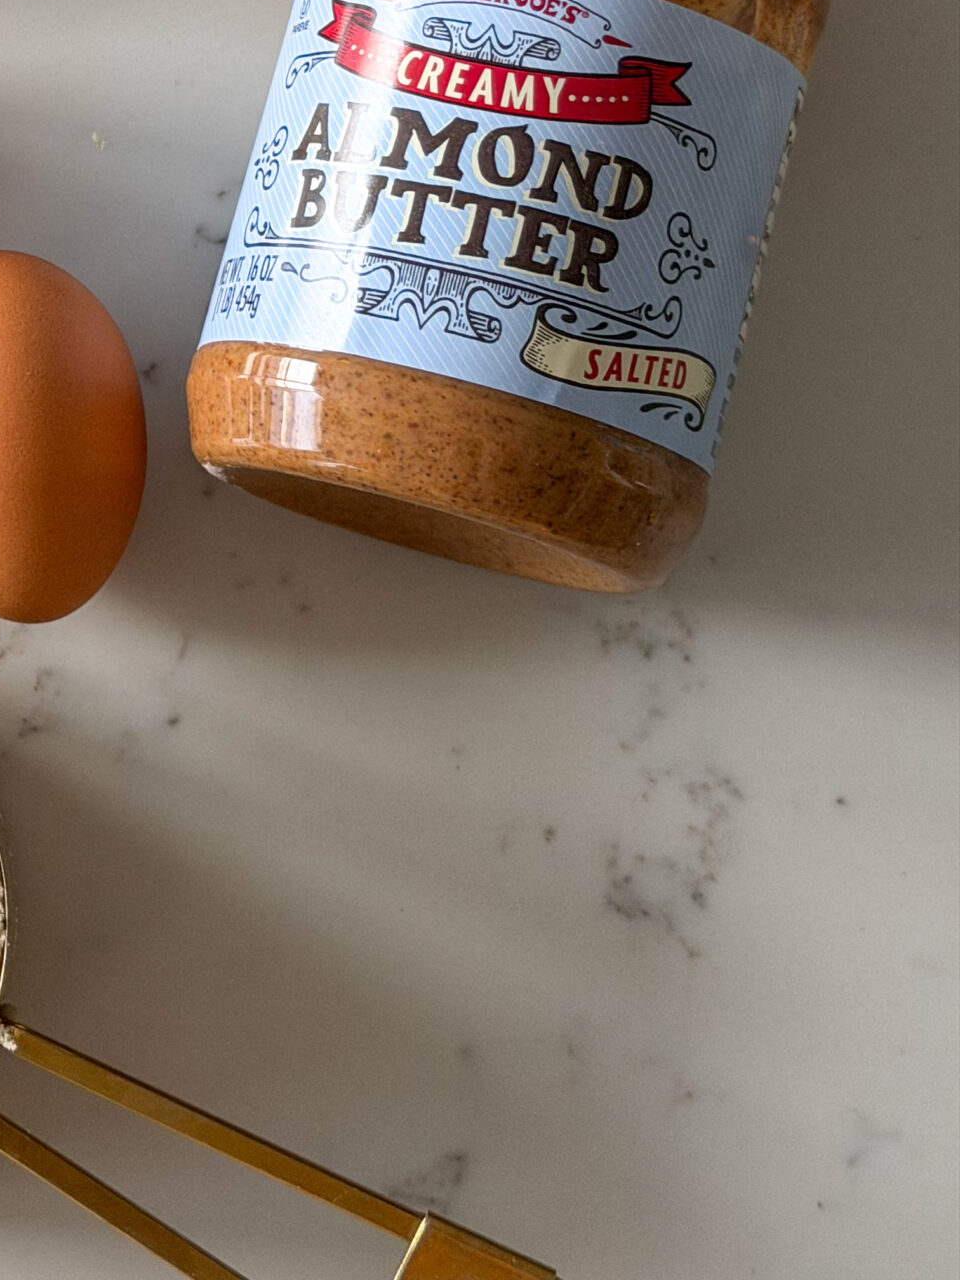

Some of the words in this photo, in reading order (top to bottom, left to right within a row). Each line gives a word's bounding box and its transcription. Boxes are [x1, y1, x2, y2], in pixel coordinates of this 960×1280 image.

[396, 50, 567, 115] CREAMY
[290, 102, 655, 222] ALMOND
[290, 168, 620, 293] BUTTER
[246, 254, 261, 282] 16
[259, 254, 281, 282] OZ
[235, 284, 262, 320] 454g
[583, 349, 688, 390] SALTED
